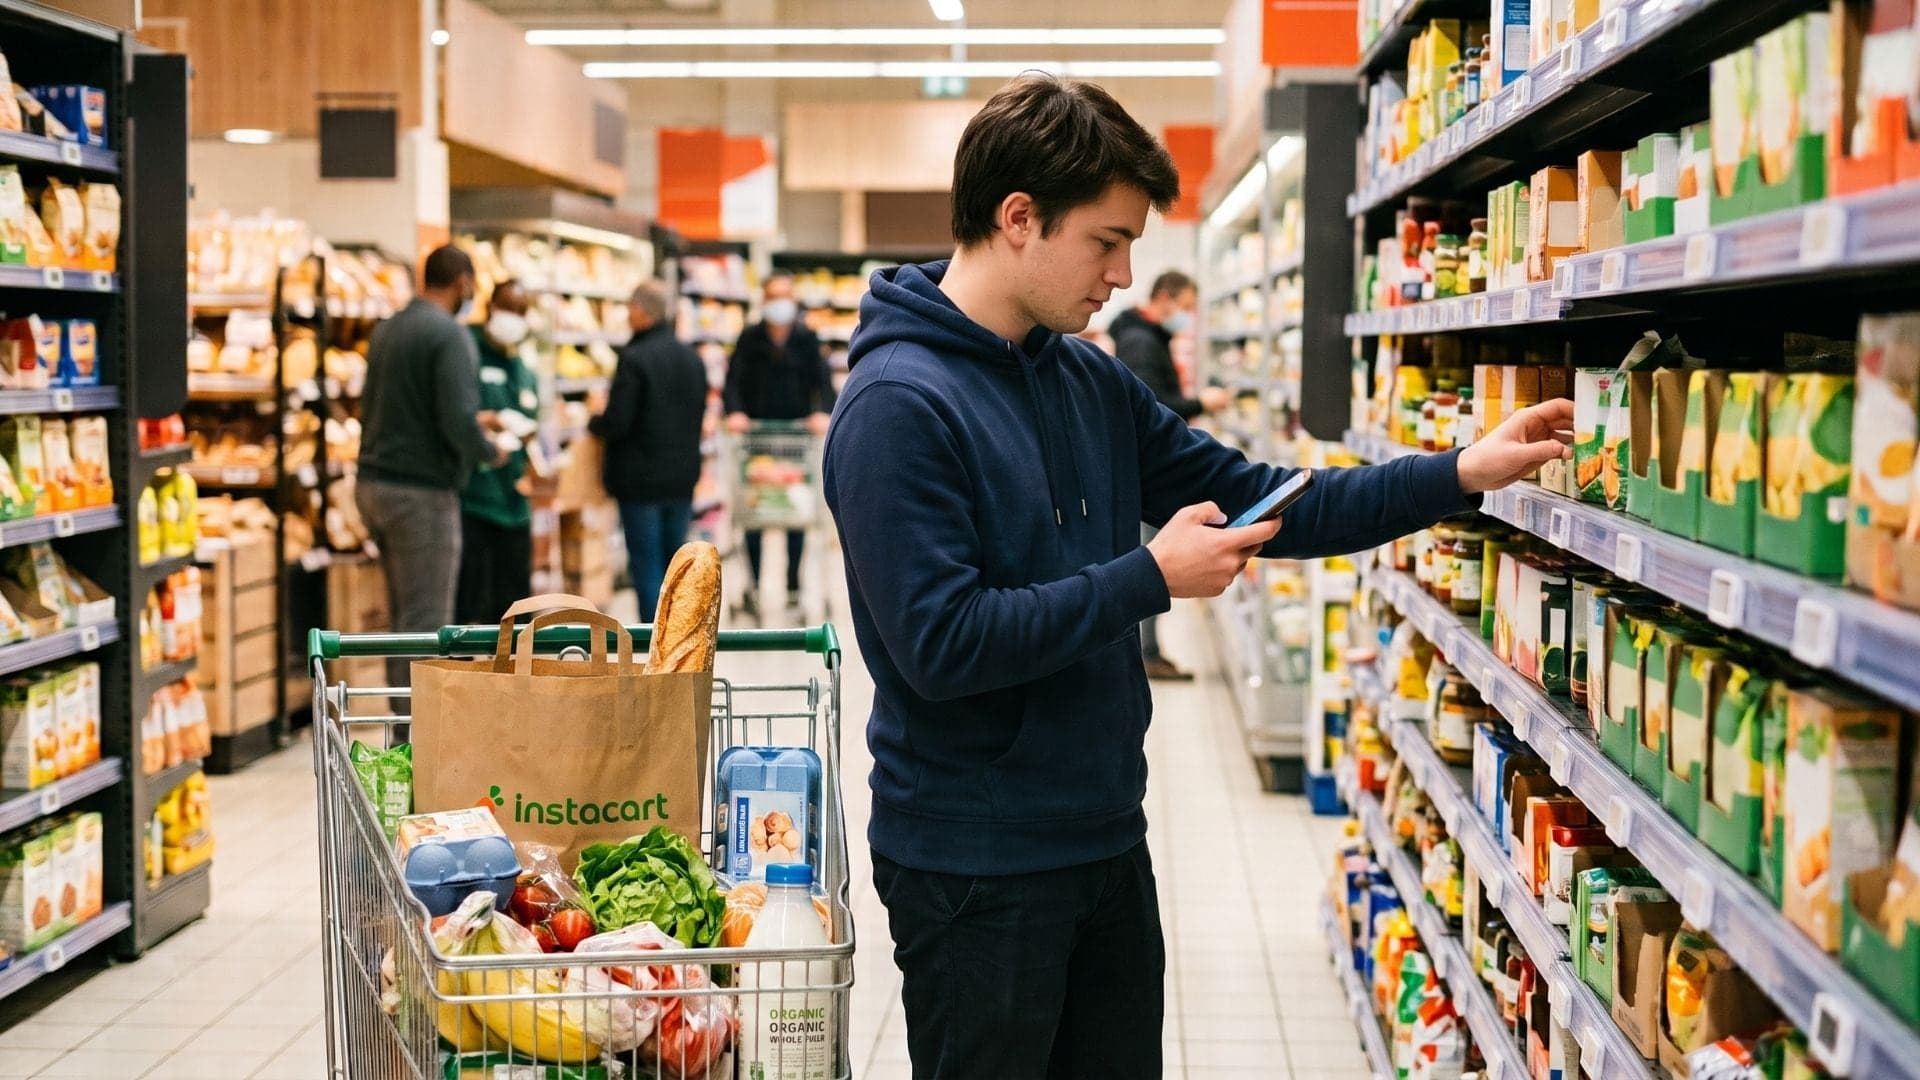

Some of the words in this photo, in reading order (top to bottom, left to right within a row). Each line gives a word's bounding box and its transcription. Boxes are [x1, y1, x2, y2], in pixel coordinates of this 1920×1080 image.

[515, 793, 669, 825] instacart
[769, 1008, 825, 1020] ORGANIC
[769, 1021, 825, 1033] ORGANIC
[769, 1035, 802, 1044] WHOLE
